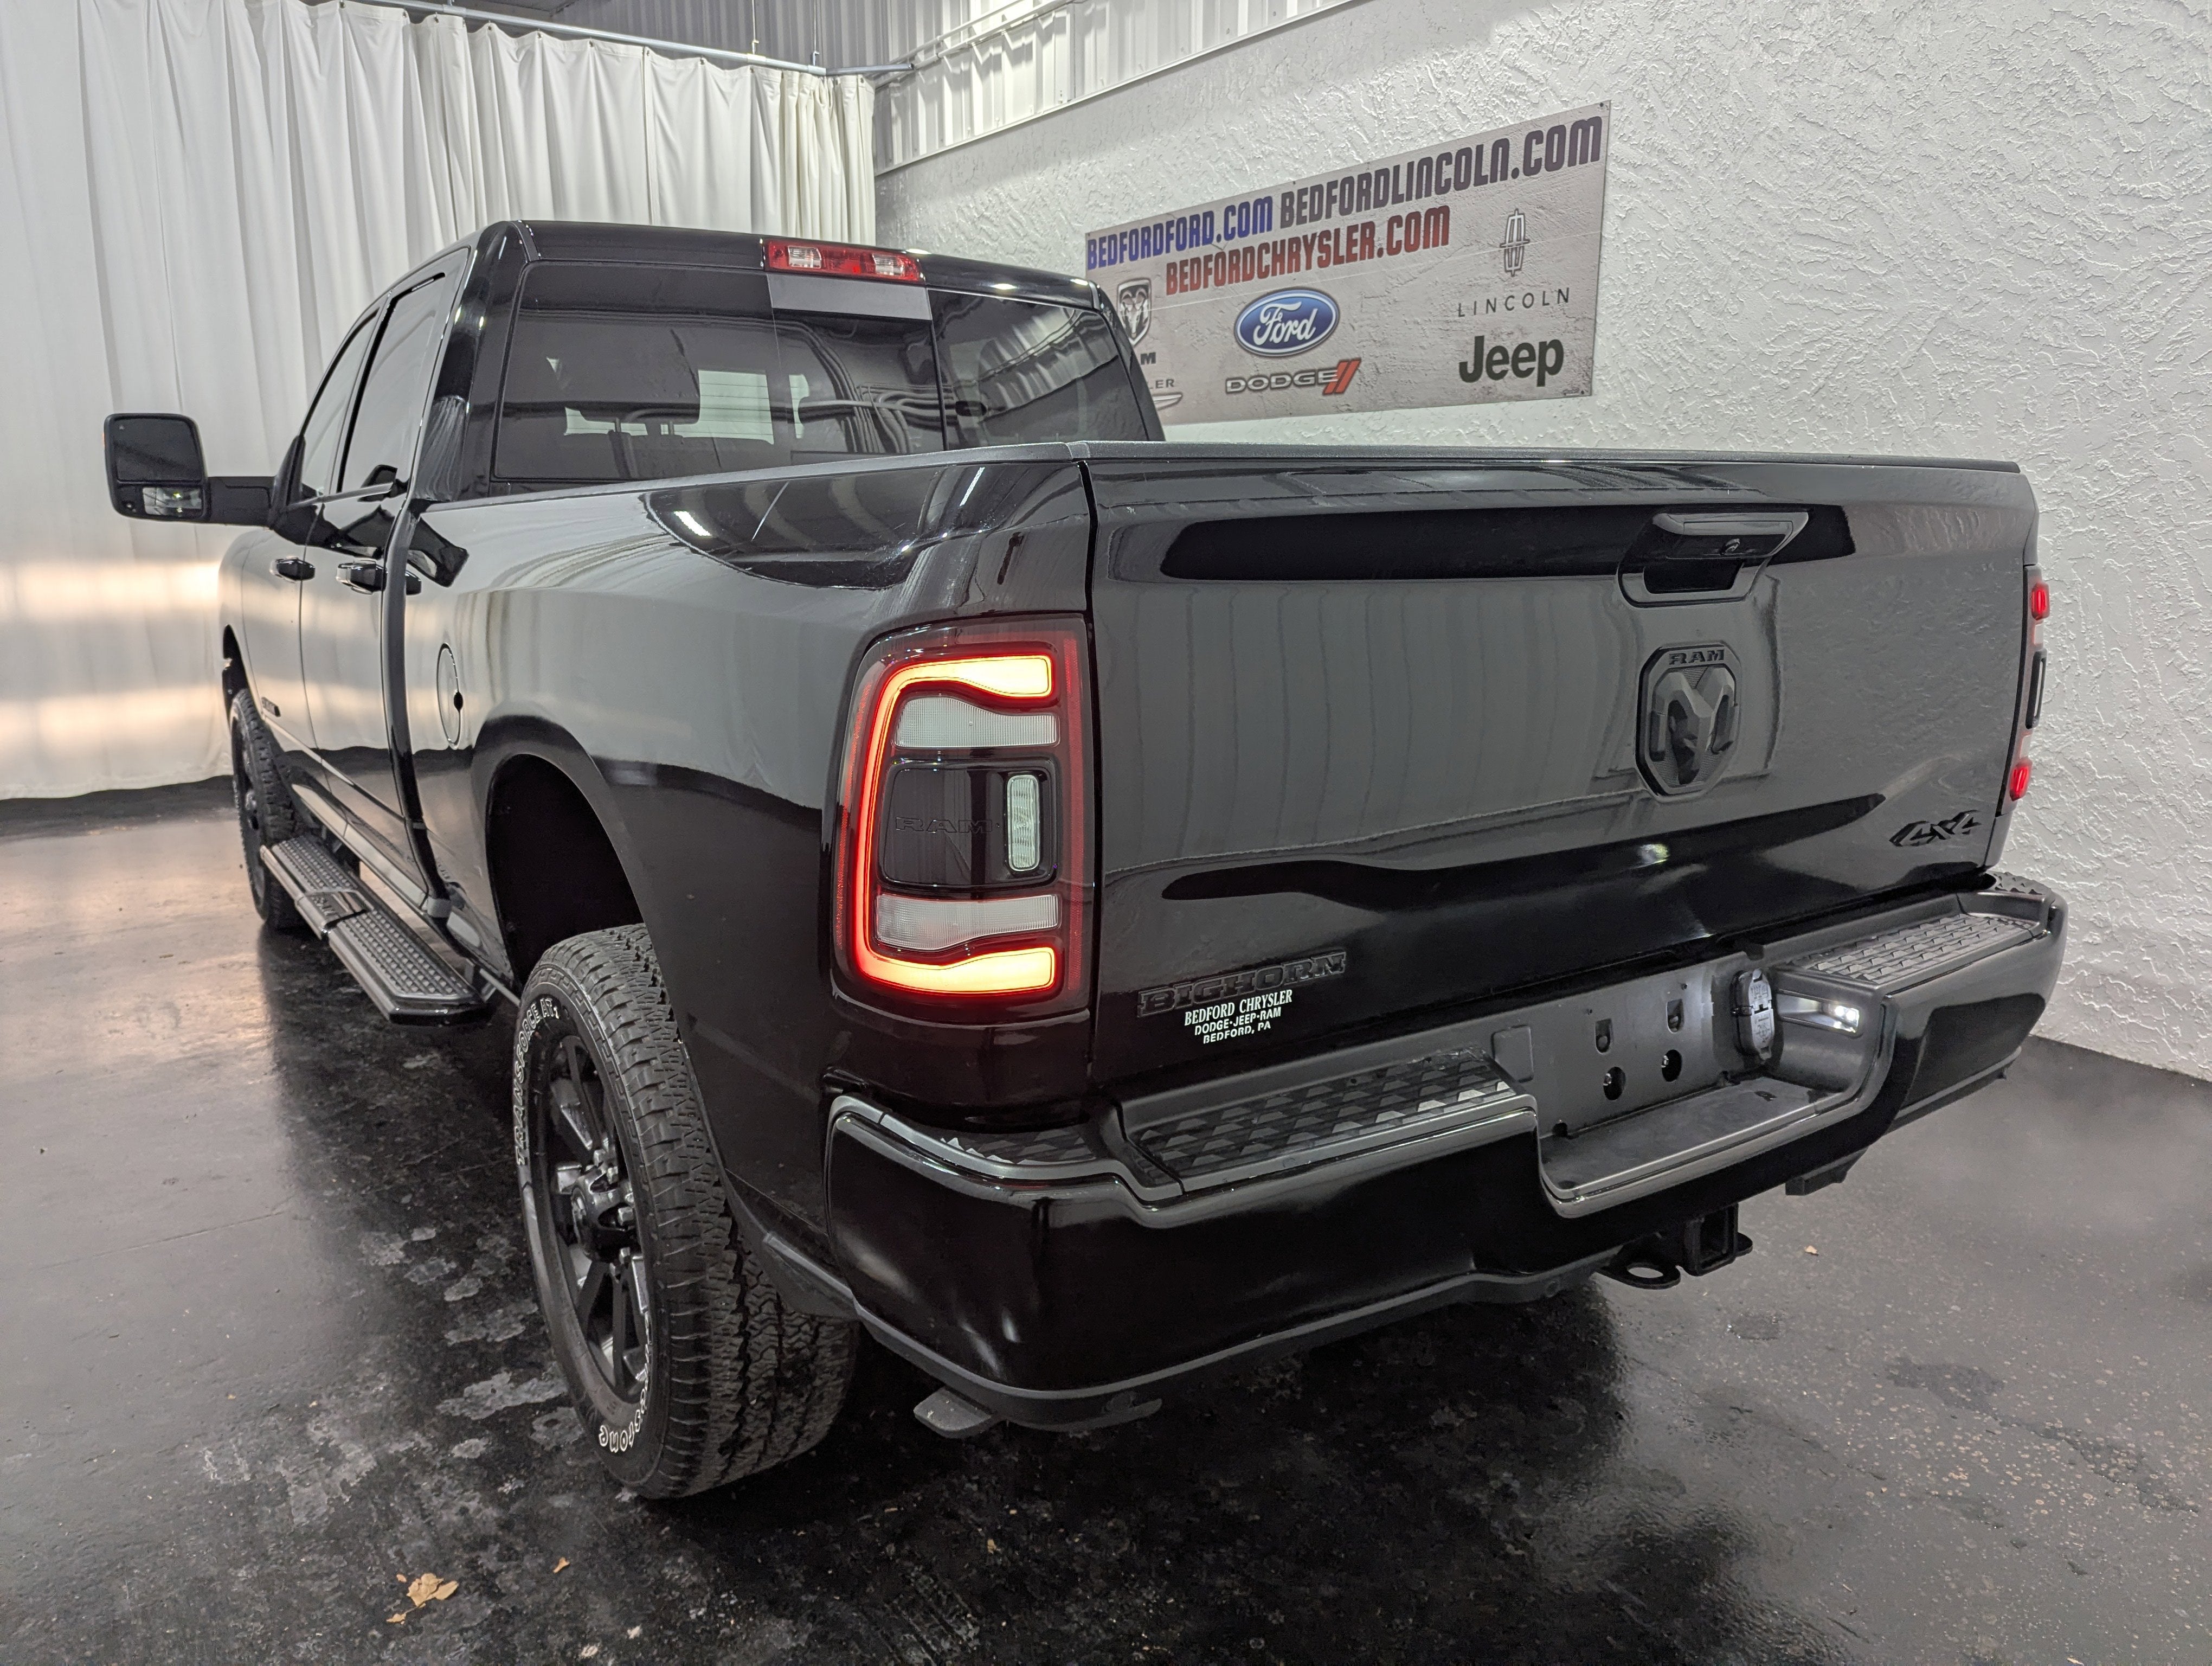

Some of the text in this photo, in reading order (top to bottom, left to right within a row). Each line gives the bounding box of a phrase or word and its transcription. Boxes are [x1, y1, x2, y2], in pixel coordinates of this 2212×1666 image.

[1088, 116, 1603, 271] BEDFORDFORD.COM BEDFORDLINCOLN.COM
[1166, 205, 1450, 296] BEDFORDCHRYSLER.COM
[1458, 287, 1569, 317] LINCOLN
[1252, 302, 1319, 345] Ford
[1458, 335, 1564, 387] Jeep
[1225, 367, 1340, 395] DODGE
[1669, 649, 1725, 665] RAM
[896, 816, 993, 834] RAM
[1184, 989, 1293, 1026] BEDFORD CHRYSLER
[1203, 1021, 1271, 1044] BEDFORD, PA
